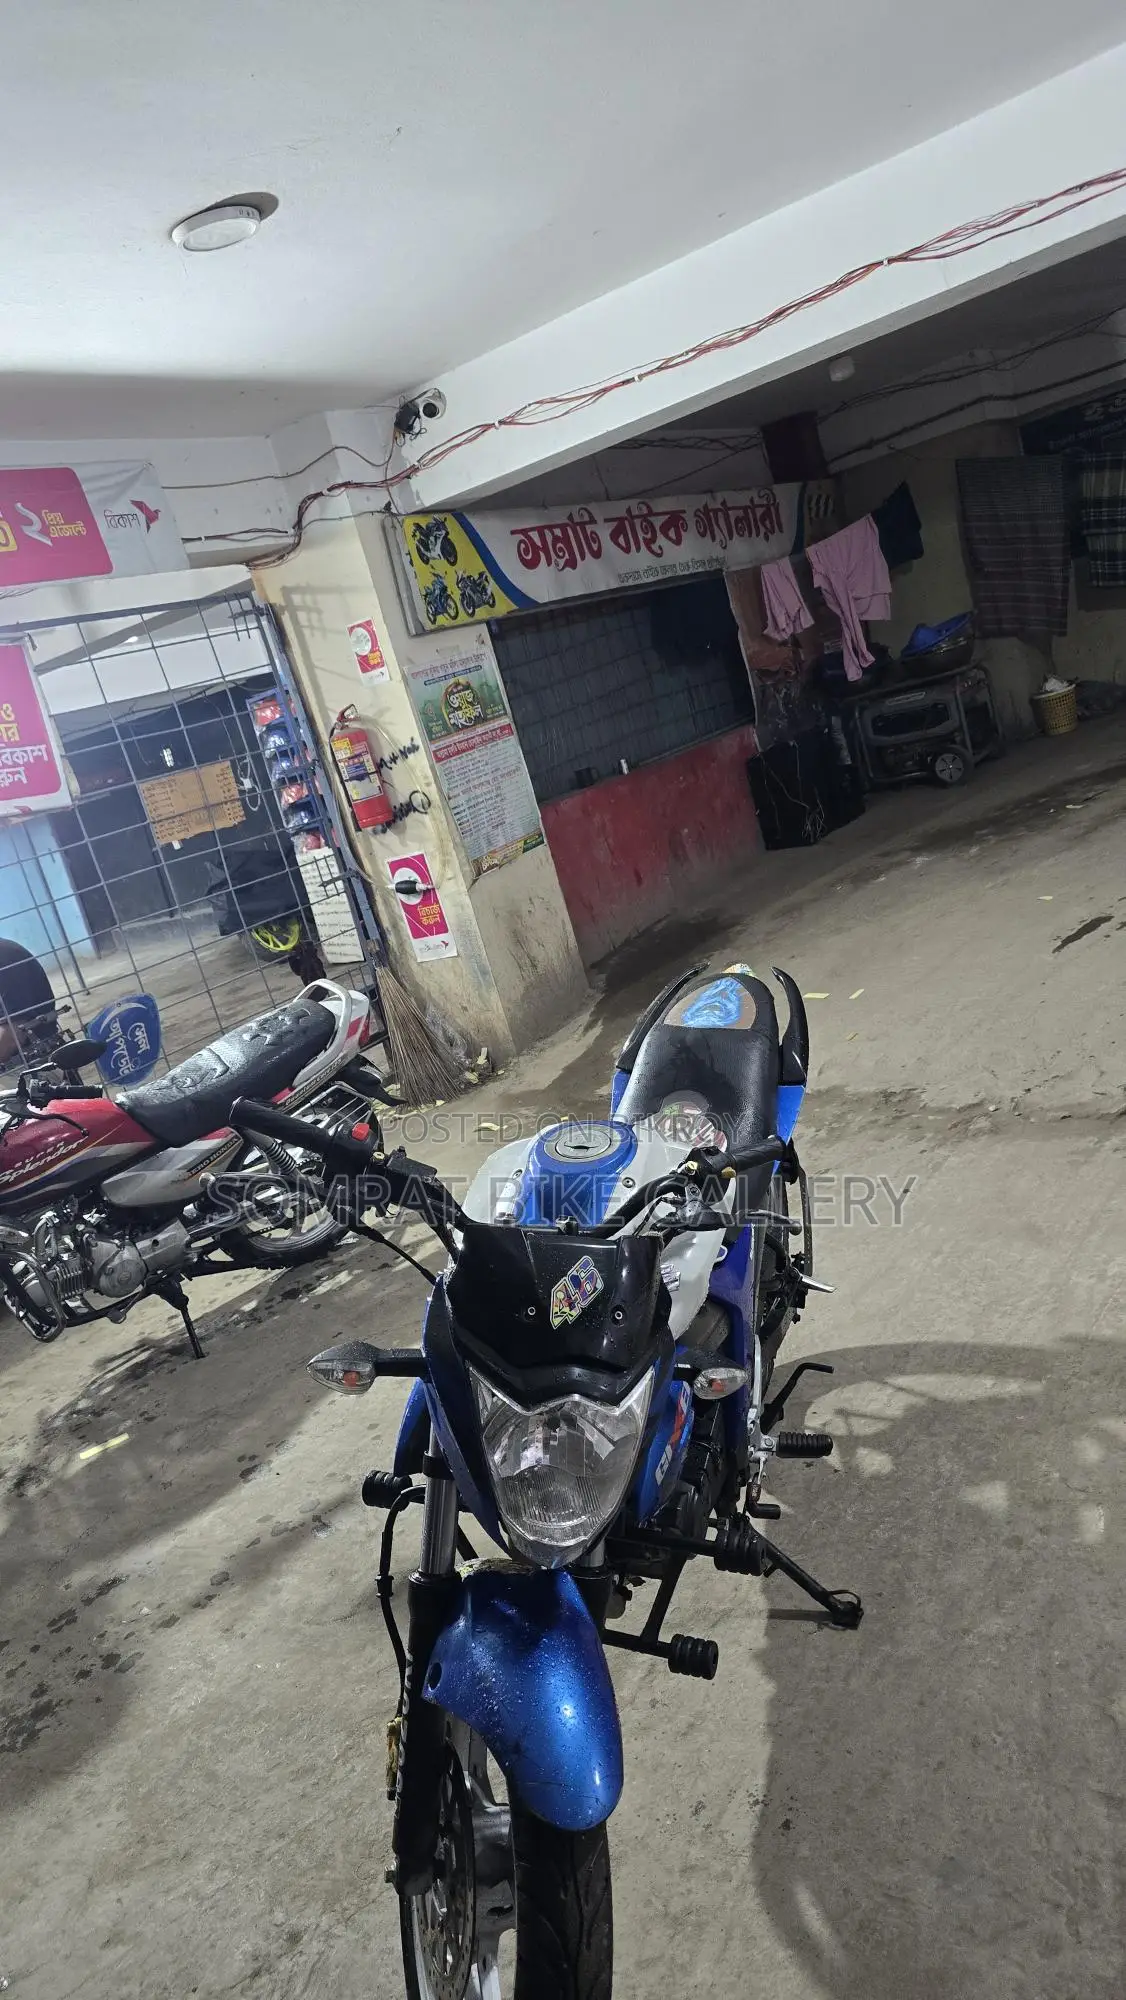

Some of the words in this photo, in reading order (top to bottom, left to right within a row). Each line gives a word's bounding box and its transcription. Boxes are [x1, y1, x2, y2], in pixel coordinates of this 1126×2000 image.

[104, 509, 141, 529] বিকাশ
[510, 507, 602, 571] সম্রাট
[604, 501, 688, 558] বাইক
[694, 487, 784, 549] গ্যালারী
[0, 1136, 89, 1184] Splendor
[550, 1255, 604, 1330] 46
